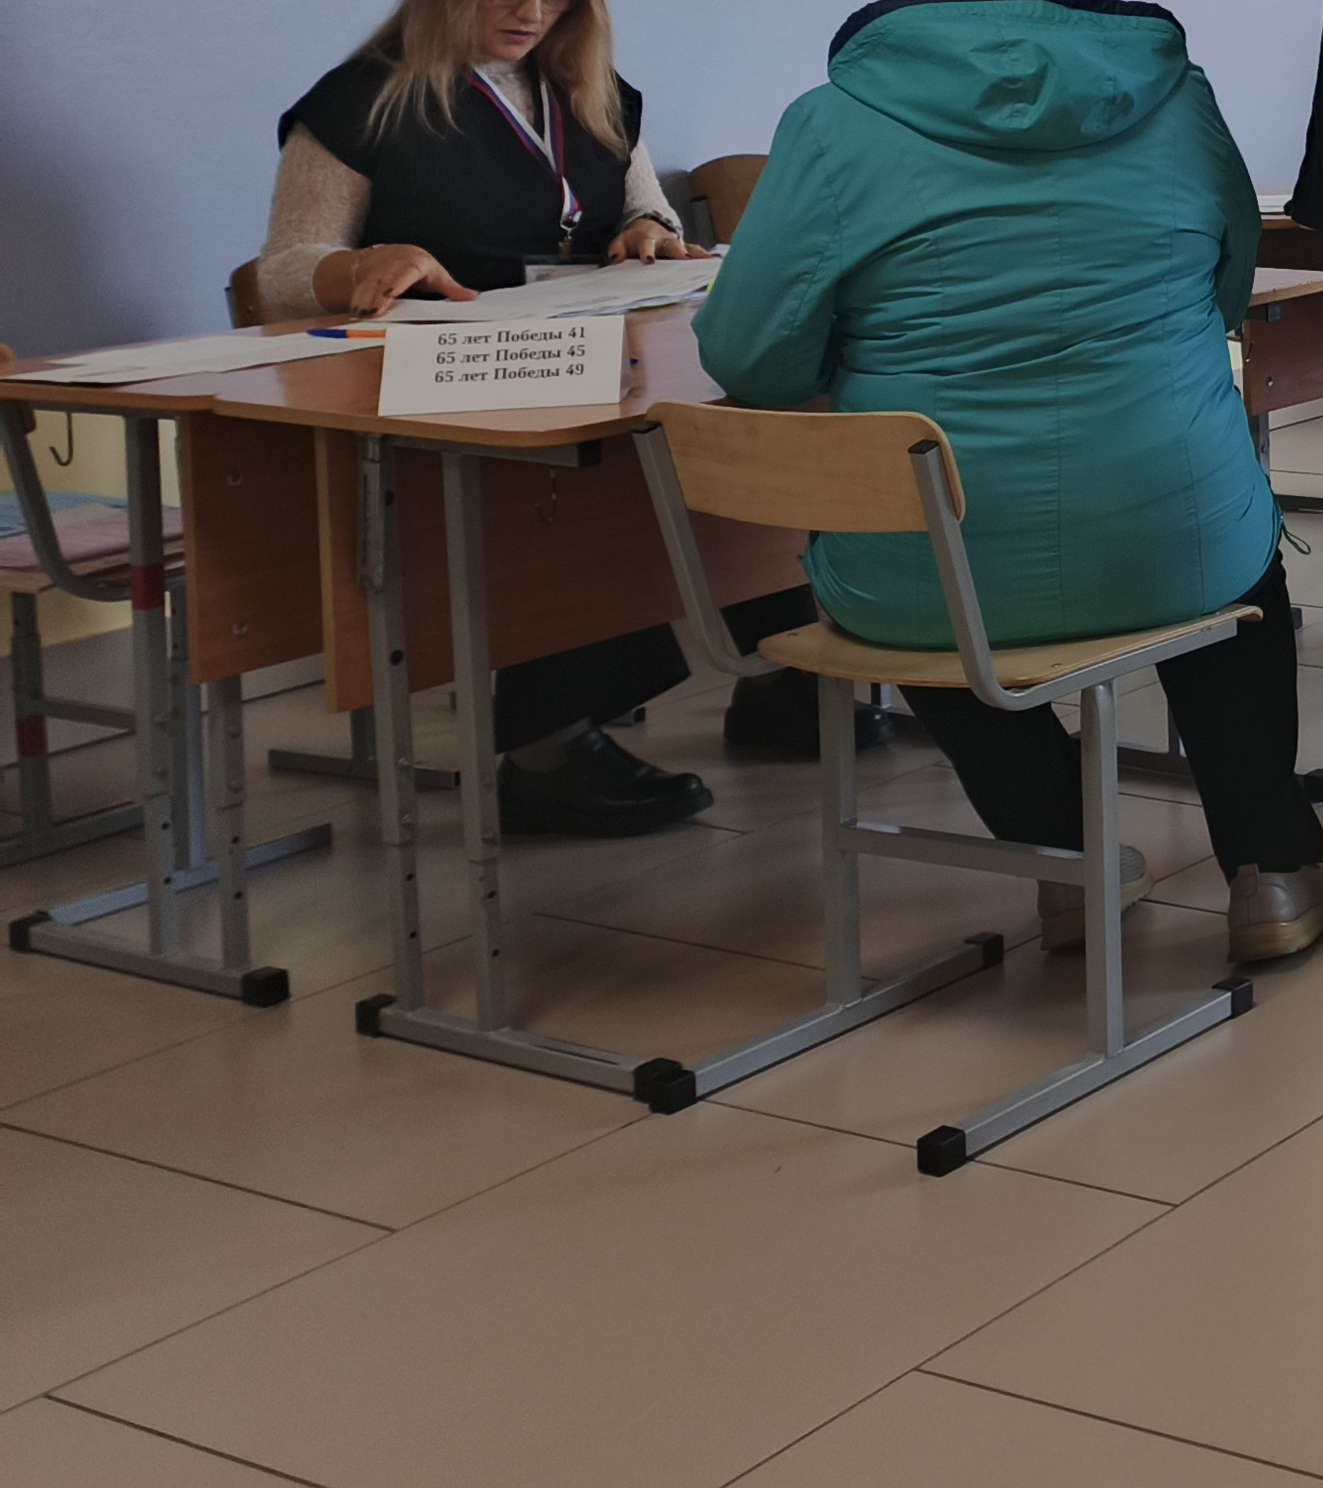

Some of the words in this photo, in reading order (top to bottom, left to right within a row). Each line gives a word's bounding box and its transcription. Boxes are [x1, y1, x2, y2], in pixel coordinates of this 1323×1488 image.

[438, 332, 457, 345] 65
[462, 334, 492, 345] лет
[497, 330, 563, 343] Победы
[568, 326, 586, 339] 41
[436, 351, 456, 364] 65
[460, 353, 490, 364] лет
[495, 348, 562, 362] Победы
[566, 344, 586, 357] 45
[434, 370, 454, 383] 65
[458, 372, 489, 383] лет
[493, 367, 560, 380] Победы
[565, 363, 585, 376] 49
